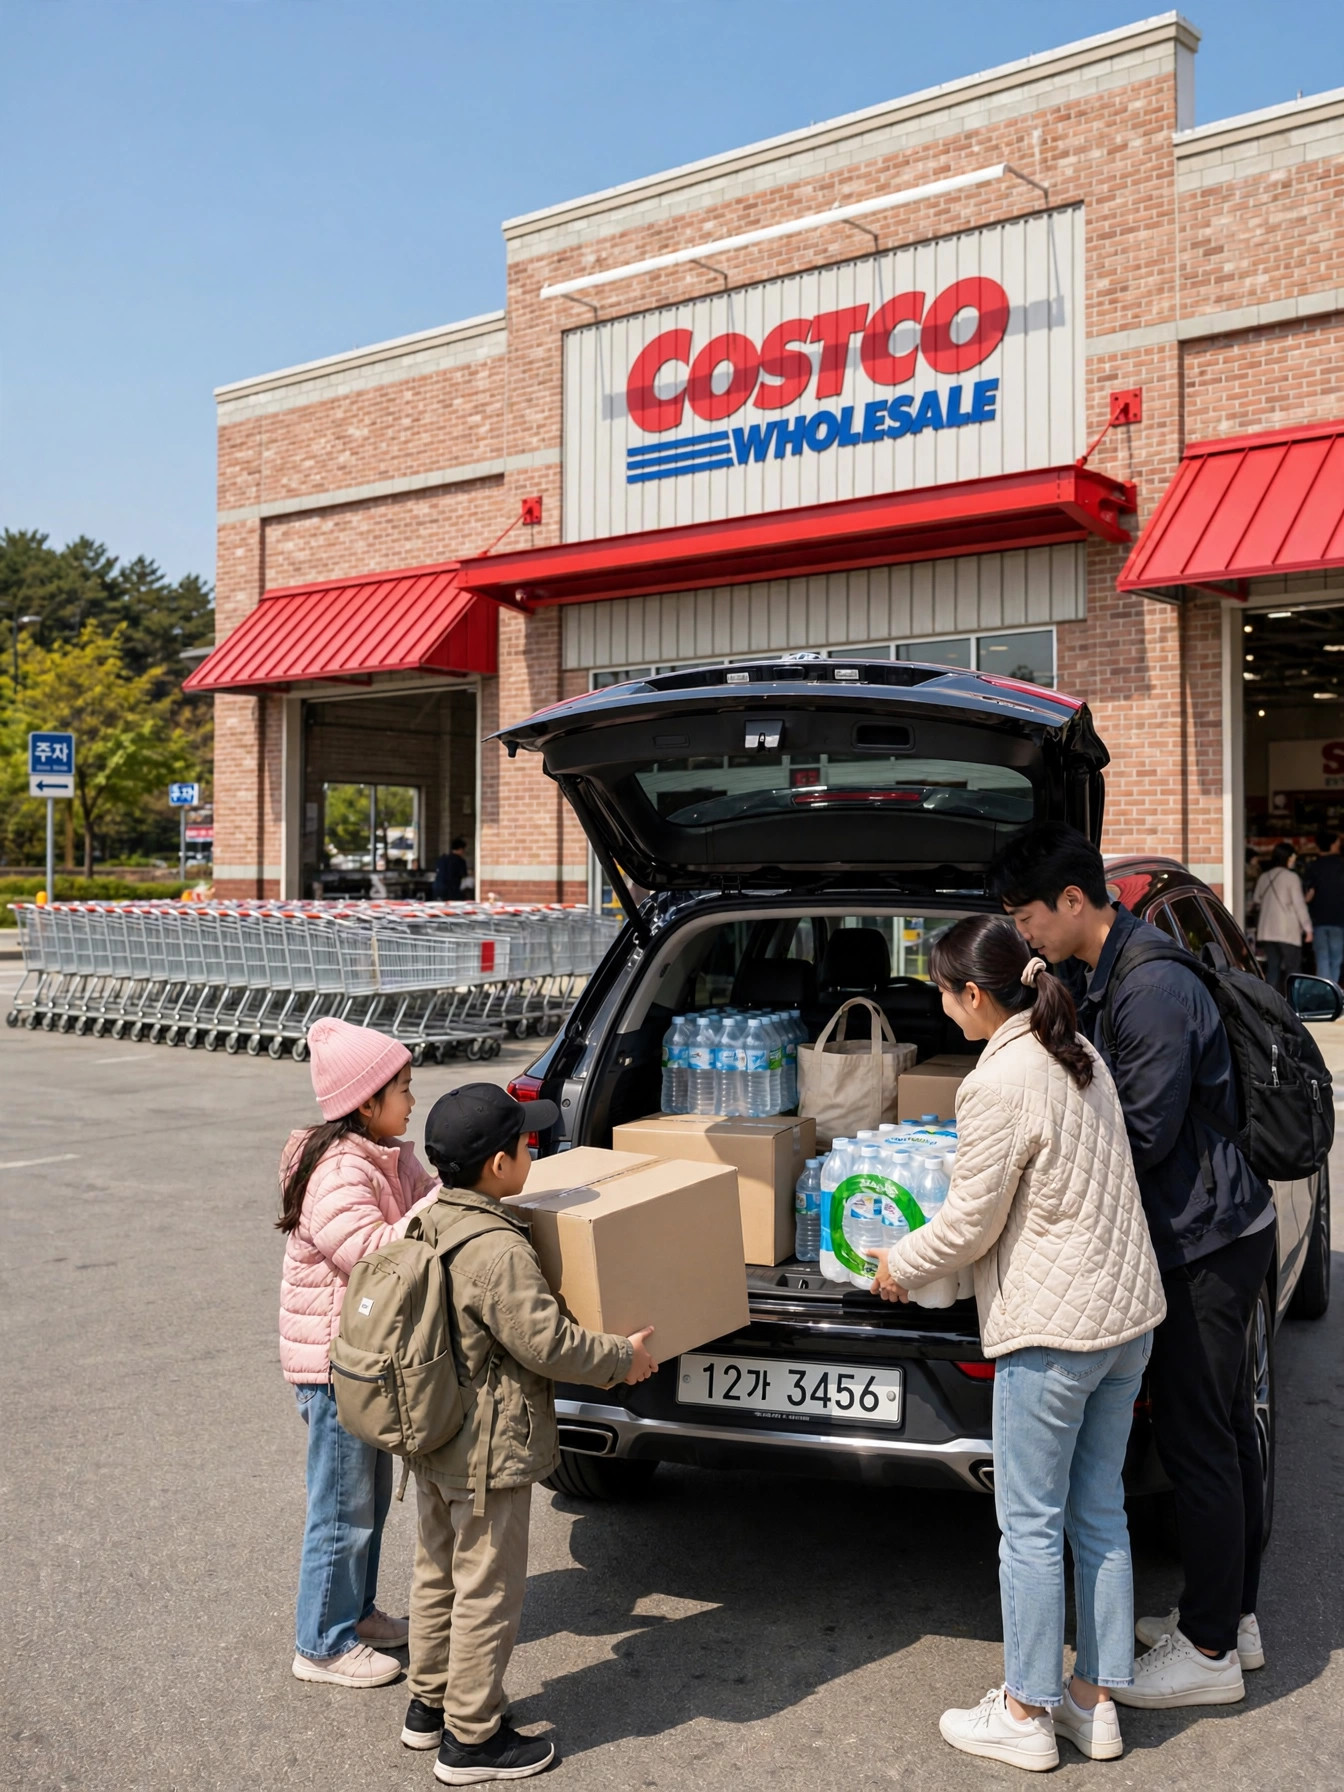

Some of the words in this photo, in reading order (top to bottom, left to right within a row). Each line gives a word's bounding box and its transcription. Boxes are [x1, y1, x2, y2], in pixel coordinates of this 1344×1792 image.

[626, 276, 1010, 433] COSTCO
[732, 378, 999, 466] WHOLESALE
[35, 742, 69, 762] 주자
[702, 1362, 771, 1401] 12가
[786, 1368, 880, 1413] 3456
